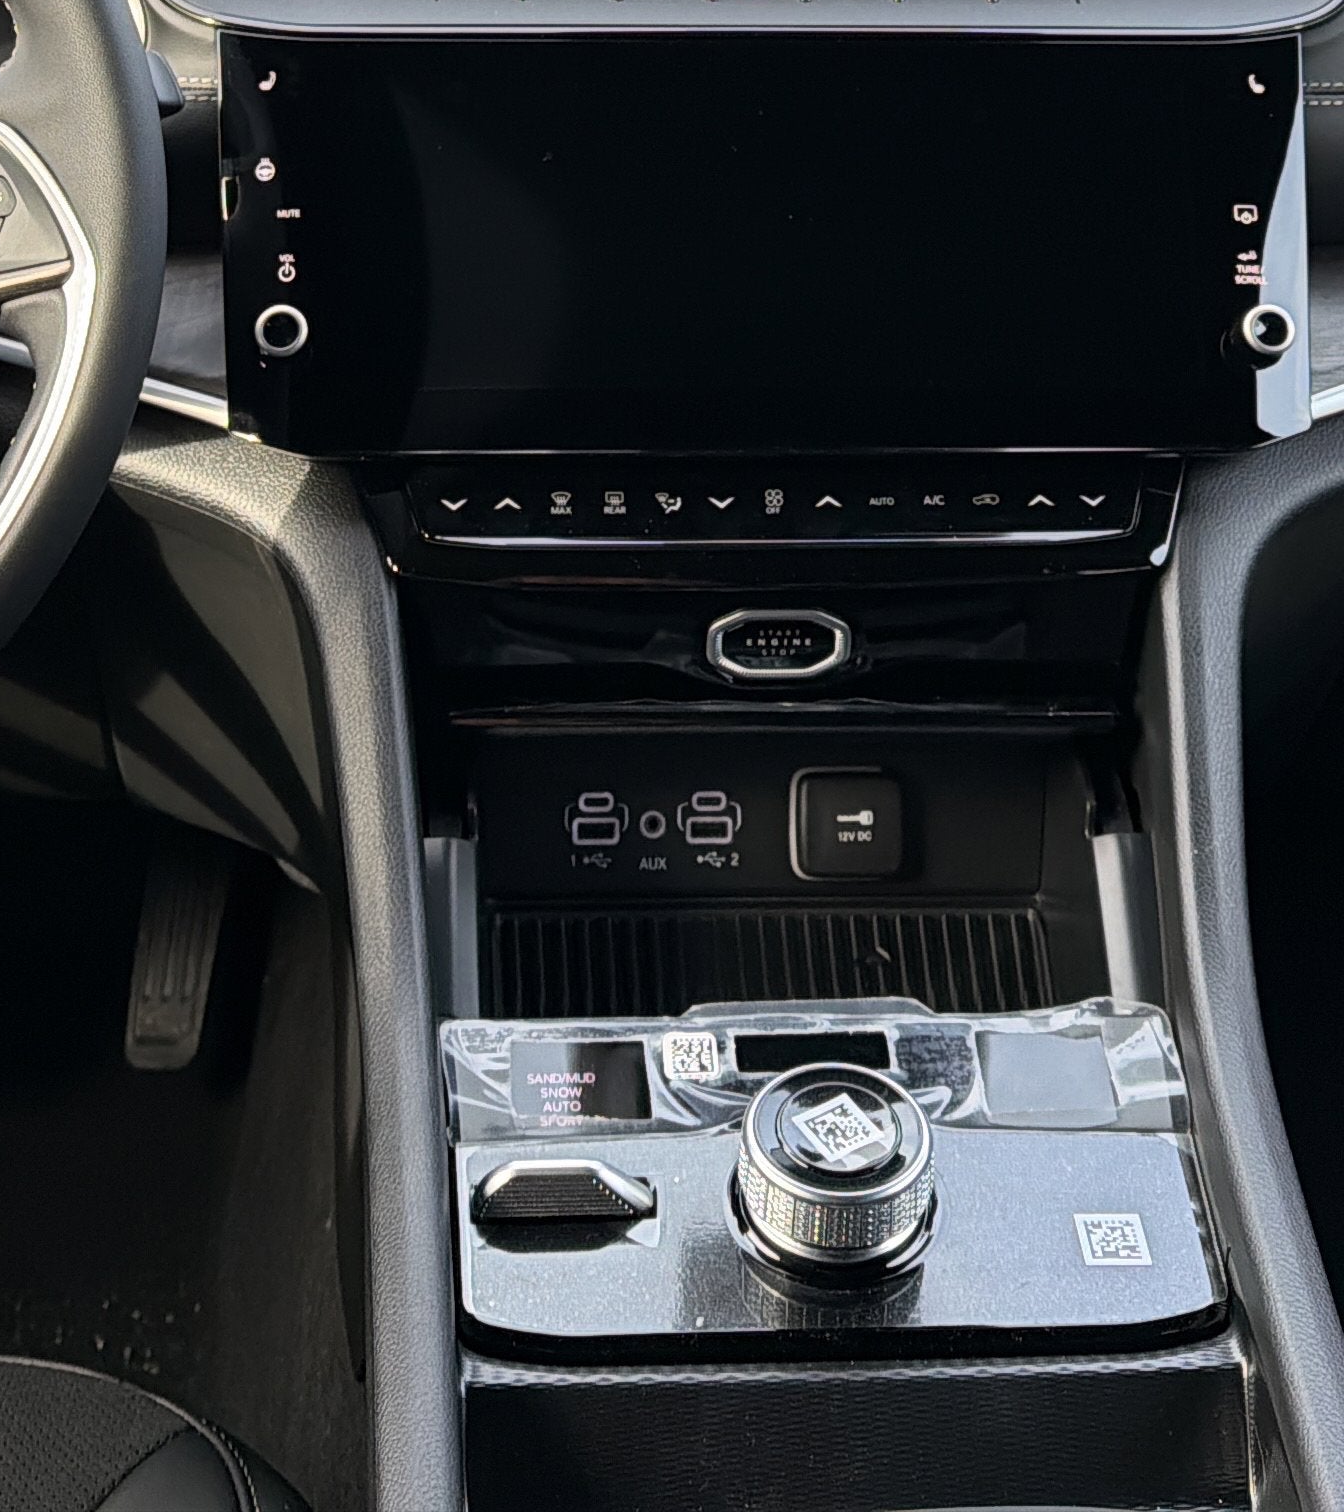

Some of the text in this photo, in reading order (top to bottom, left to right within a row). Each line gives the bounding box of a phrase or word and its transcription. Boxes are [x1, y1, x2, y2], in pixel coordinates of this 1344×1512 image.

[277, 208, 301, 219] MUTE
[868, 496, 895, 506] AUTO
[923, 494, 946, 506] A/C
[550, 506, 573, 515] MAX
[603, 506, 627, 515] REAR
[765, 506, 781, 515] OFF
[745, 638, 812, 647] ENGINE
[837, 831, 872, 842] 12V DC
[639, 856, 668, 871] AUX
[730, 853, 739, 867] 2
[526, 1072, 596, 1085] SAND/MUD
[540, 1087, 583, 1099] SNOW
[543, 1100, 582, 1113] AUTO
